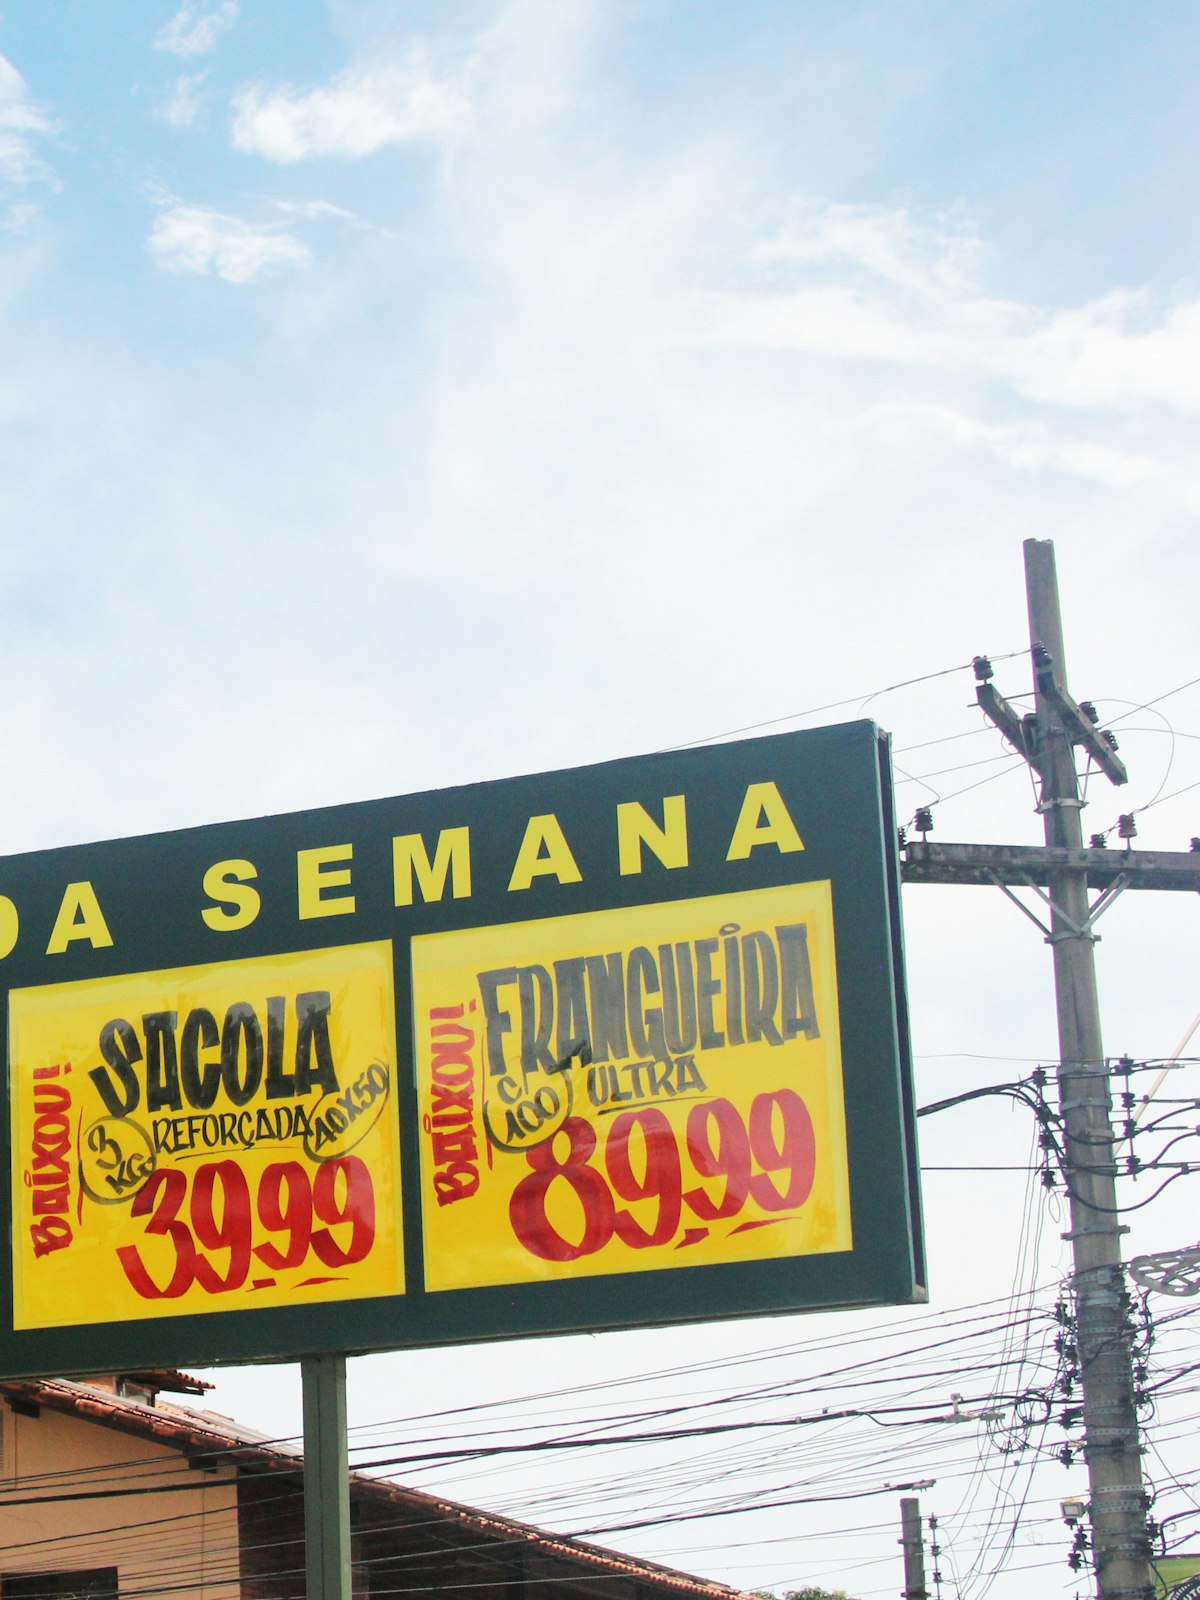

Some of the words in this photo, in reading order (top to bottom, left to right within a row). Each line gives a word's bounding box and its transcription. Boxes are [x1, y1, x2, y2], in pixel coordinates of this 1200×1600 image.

[201, 781, 804, 932] SEMANA
[88, 991, 340, 1118] SACOLA
[587, 1054, 707, 1107] ULTRA
[87, 1124, 122, 1169] 3
[153, 1105, 313, 1153] REFORÇADA
[504, 1085, 561, 1145] 100
[509, 1088, 816, 1261] 89,99
[116, 1155, 376, 1299] 39,99
